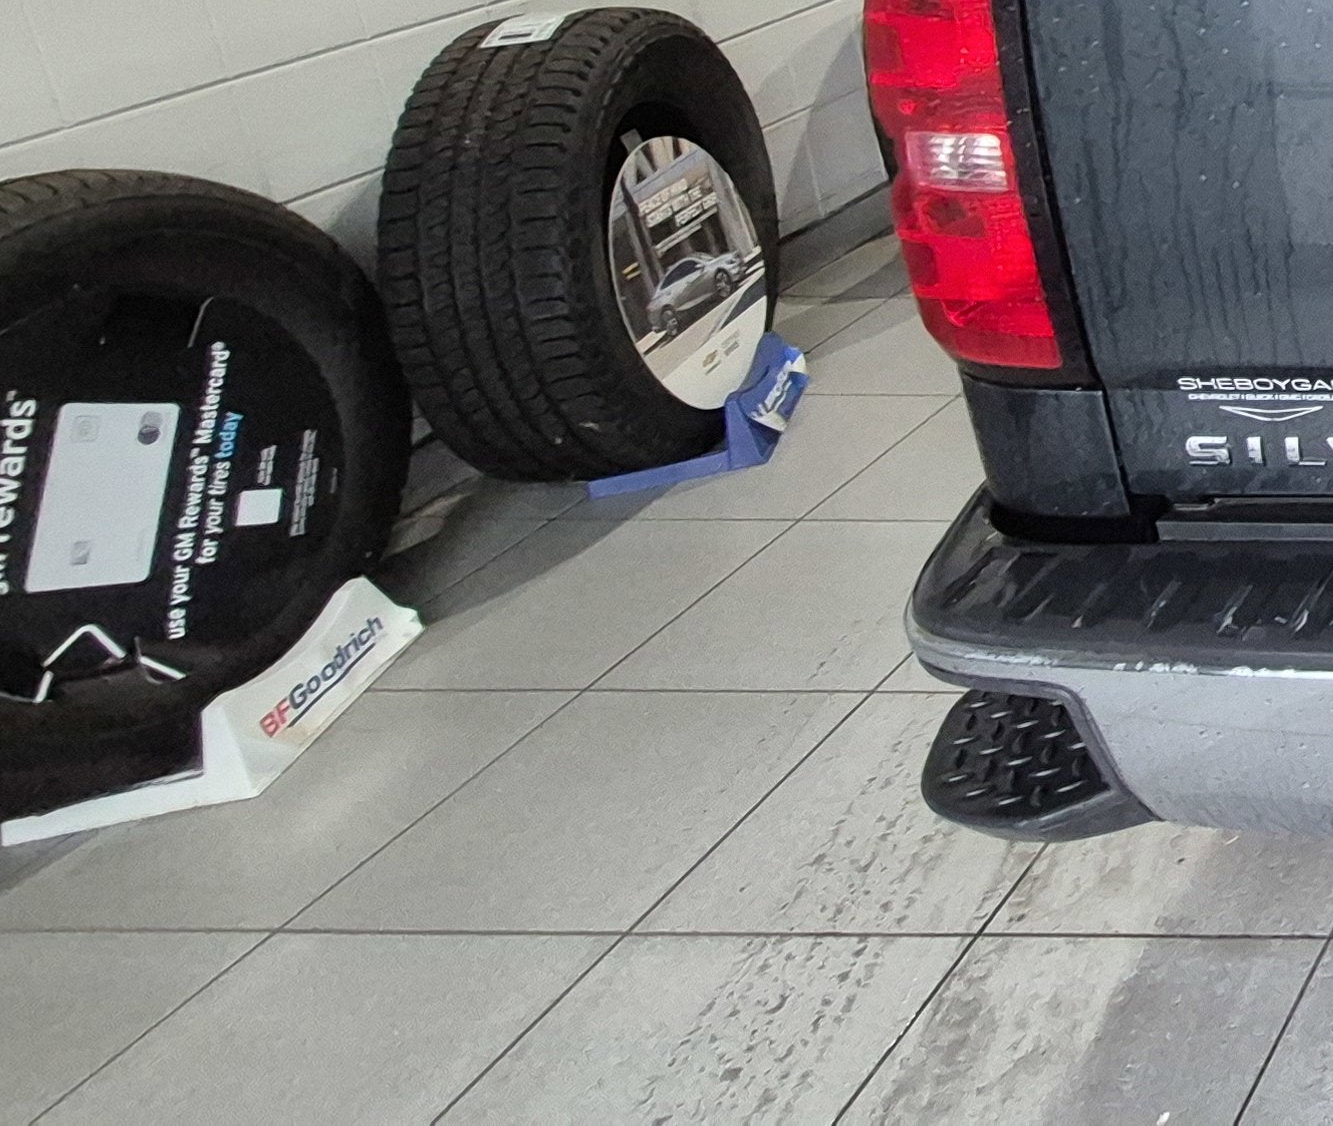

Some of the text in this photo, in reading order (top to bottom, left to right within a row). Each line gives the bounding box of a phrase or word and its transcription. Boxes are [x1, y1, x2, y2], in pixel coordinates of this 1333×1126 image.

[195, 411, 244, 564] for your tires today
[173, 533, 196, 562] GM
[170, 566, 192, 605] your
[169, 608, 186, 640] use
[260, 617, 383, 738] BFGoodrich
